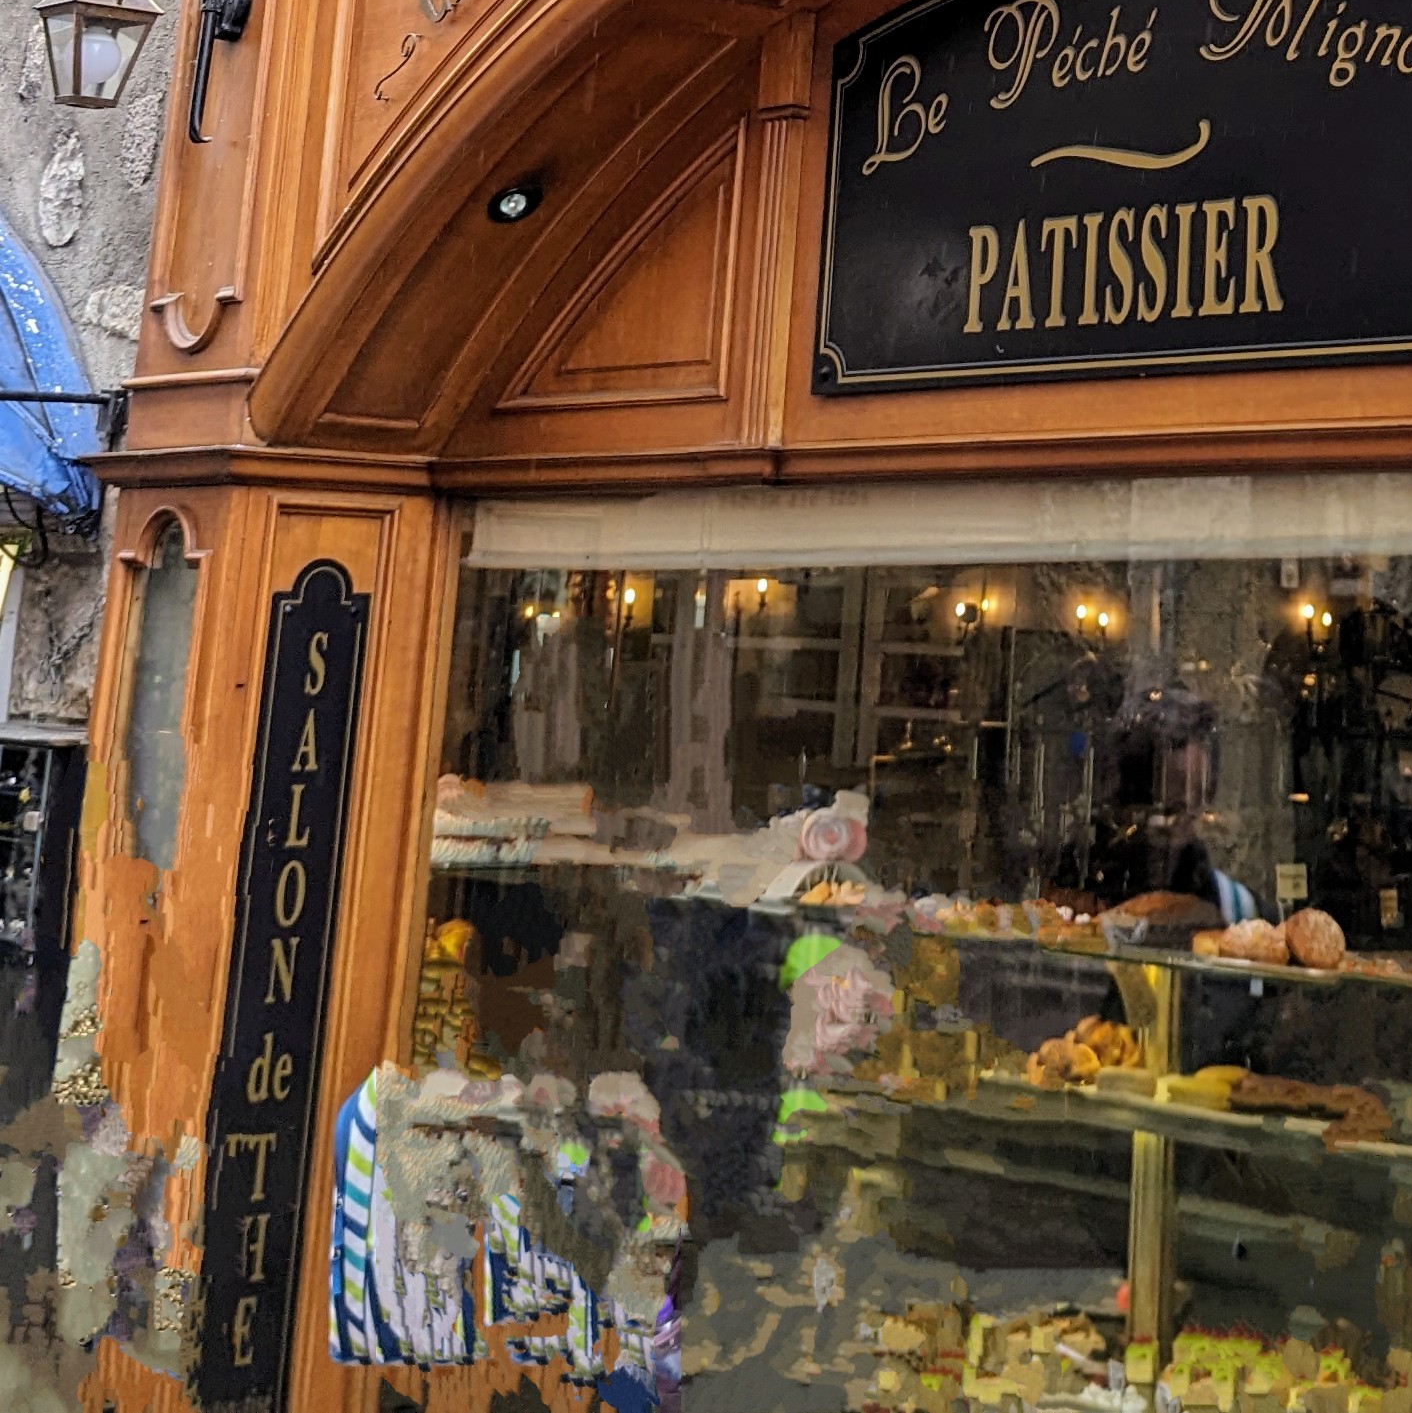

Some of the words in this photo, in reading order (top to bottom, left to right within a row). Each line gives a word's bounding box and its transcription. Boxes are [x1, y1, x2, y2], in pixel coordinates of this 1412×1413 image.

[862, 54, 949, 176] Le
[963, 194, 1286, 335] PATISSIER
[263, 630, 330, 1005] SALON
[245, 1030, 295, 1105] de
